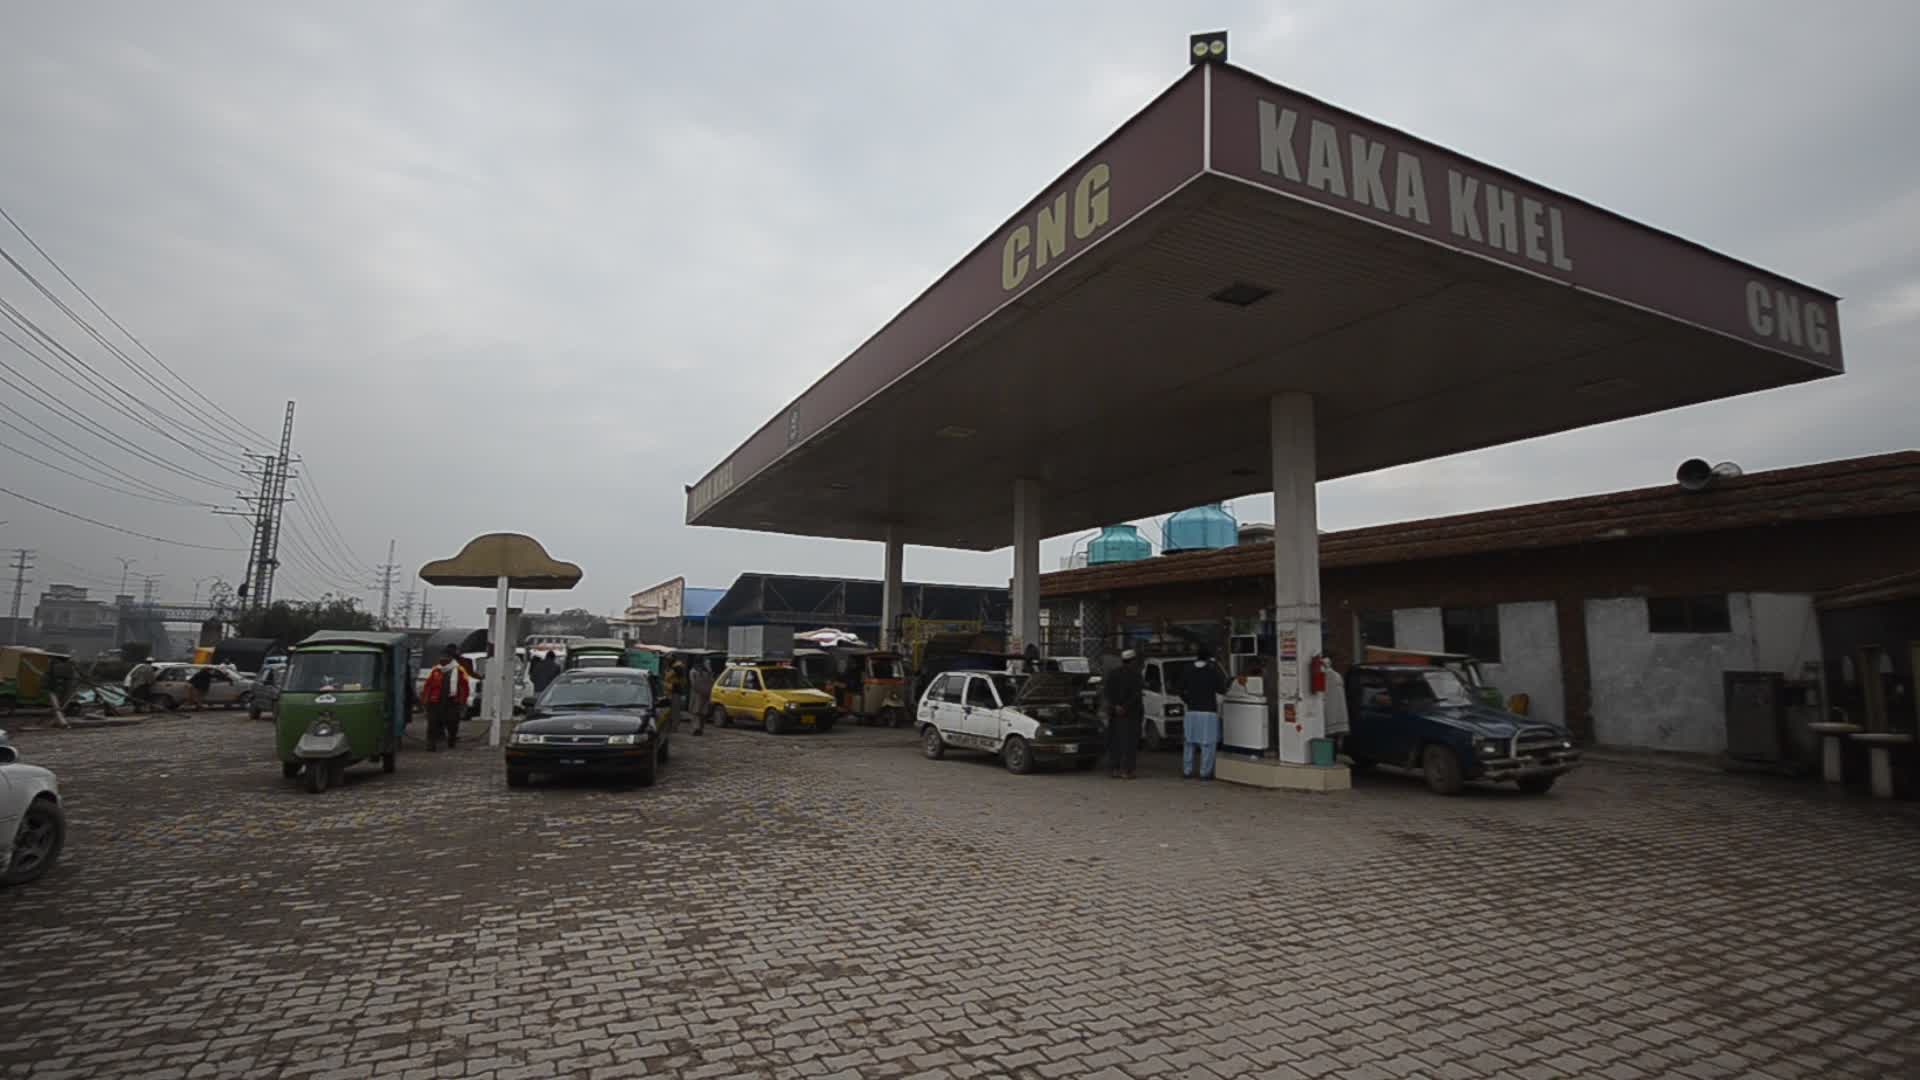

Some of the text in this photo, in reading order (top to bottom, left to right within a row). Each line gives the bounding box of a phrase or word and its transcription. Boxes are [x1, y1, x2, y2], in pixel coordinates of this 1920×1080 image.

[1002, 162, 1111, 291] CNG
[1257, 99, 1574, 272] KAKA KHEL
[1744, 280, 1831, 355] CNG
